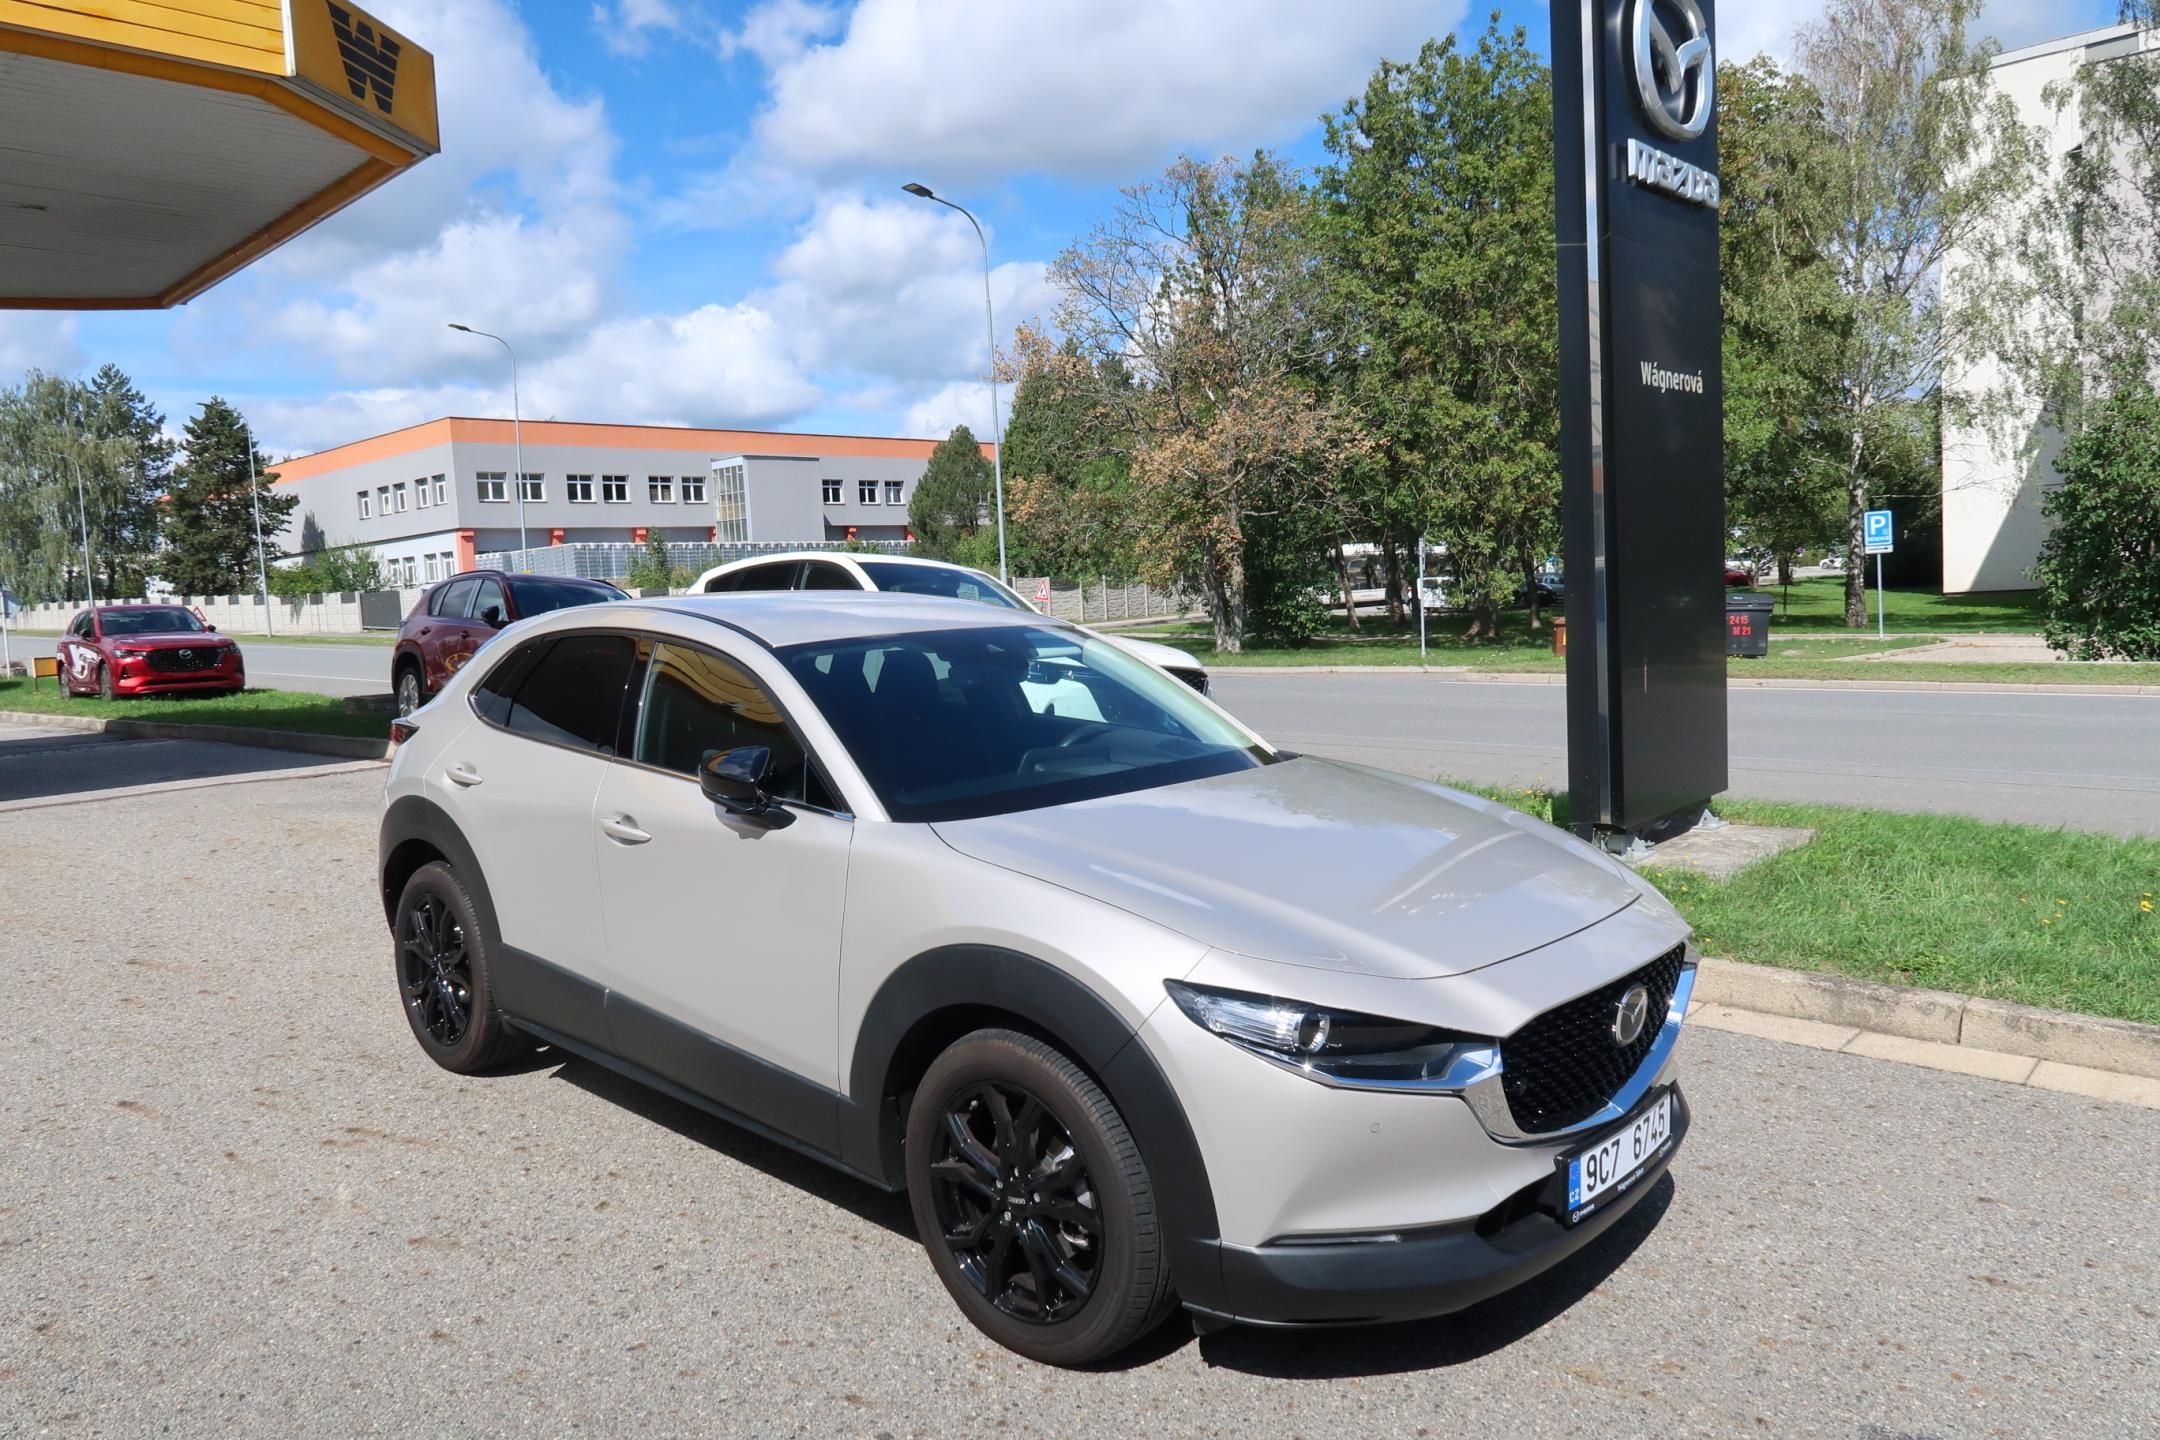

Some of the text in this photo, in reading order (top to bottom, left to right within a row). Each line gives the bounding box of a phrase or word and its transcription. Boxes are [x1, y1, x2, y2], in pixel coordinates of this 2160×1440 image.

[1627, 138, 1719, 208] mazda
[1640, 360, 1703, 394] Wágnerová
[1870, 515, 1886, 535] P
[1586, 1102, 1665, 1193] 9C7 6745
[1569, 1187, 1580, 1203] CZ
